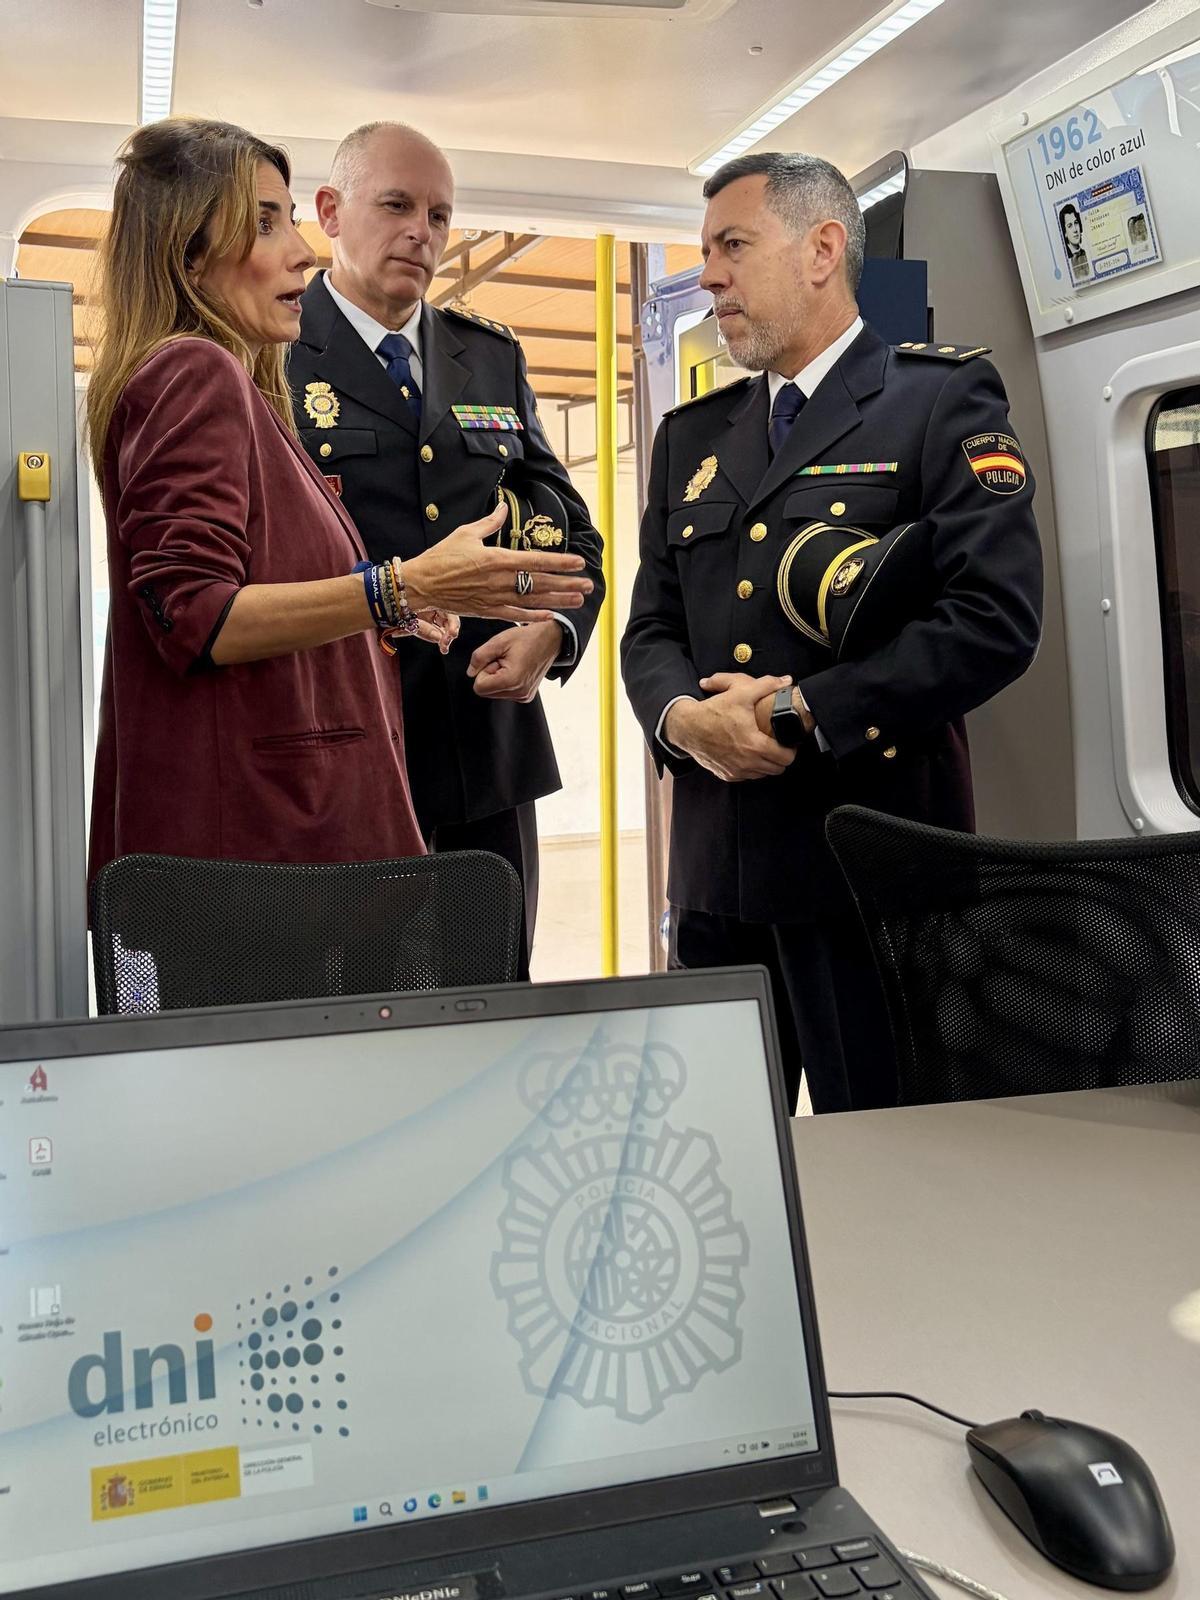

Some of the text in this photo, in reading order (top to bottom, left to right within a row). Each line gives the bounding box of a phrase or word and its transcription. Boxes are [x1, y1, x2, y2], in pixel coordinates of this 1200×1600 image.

[1036, 107, 1102, 166] 1962
[1045, 166, 1067, 191] DNI
[1069, 159, 1084, 180] de
[1086, 147, 1117, 175] color
[1120, 129, 1146, 157] azul
[966, 435, 996, 449] CUERPO
[997, 443, 1008, 451] DE
[985, 470, 1020, 485] POLICIA
[578, 1300, 685, 1341] NACIONAL
[67, 1313, 216, 1419] dni
[93, 1412, 219, 1447] electrónico
